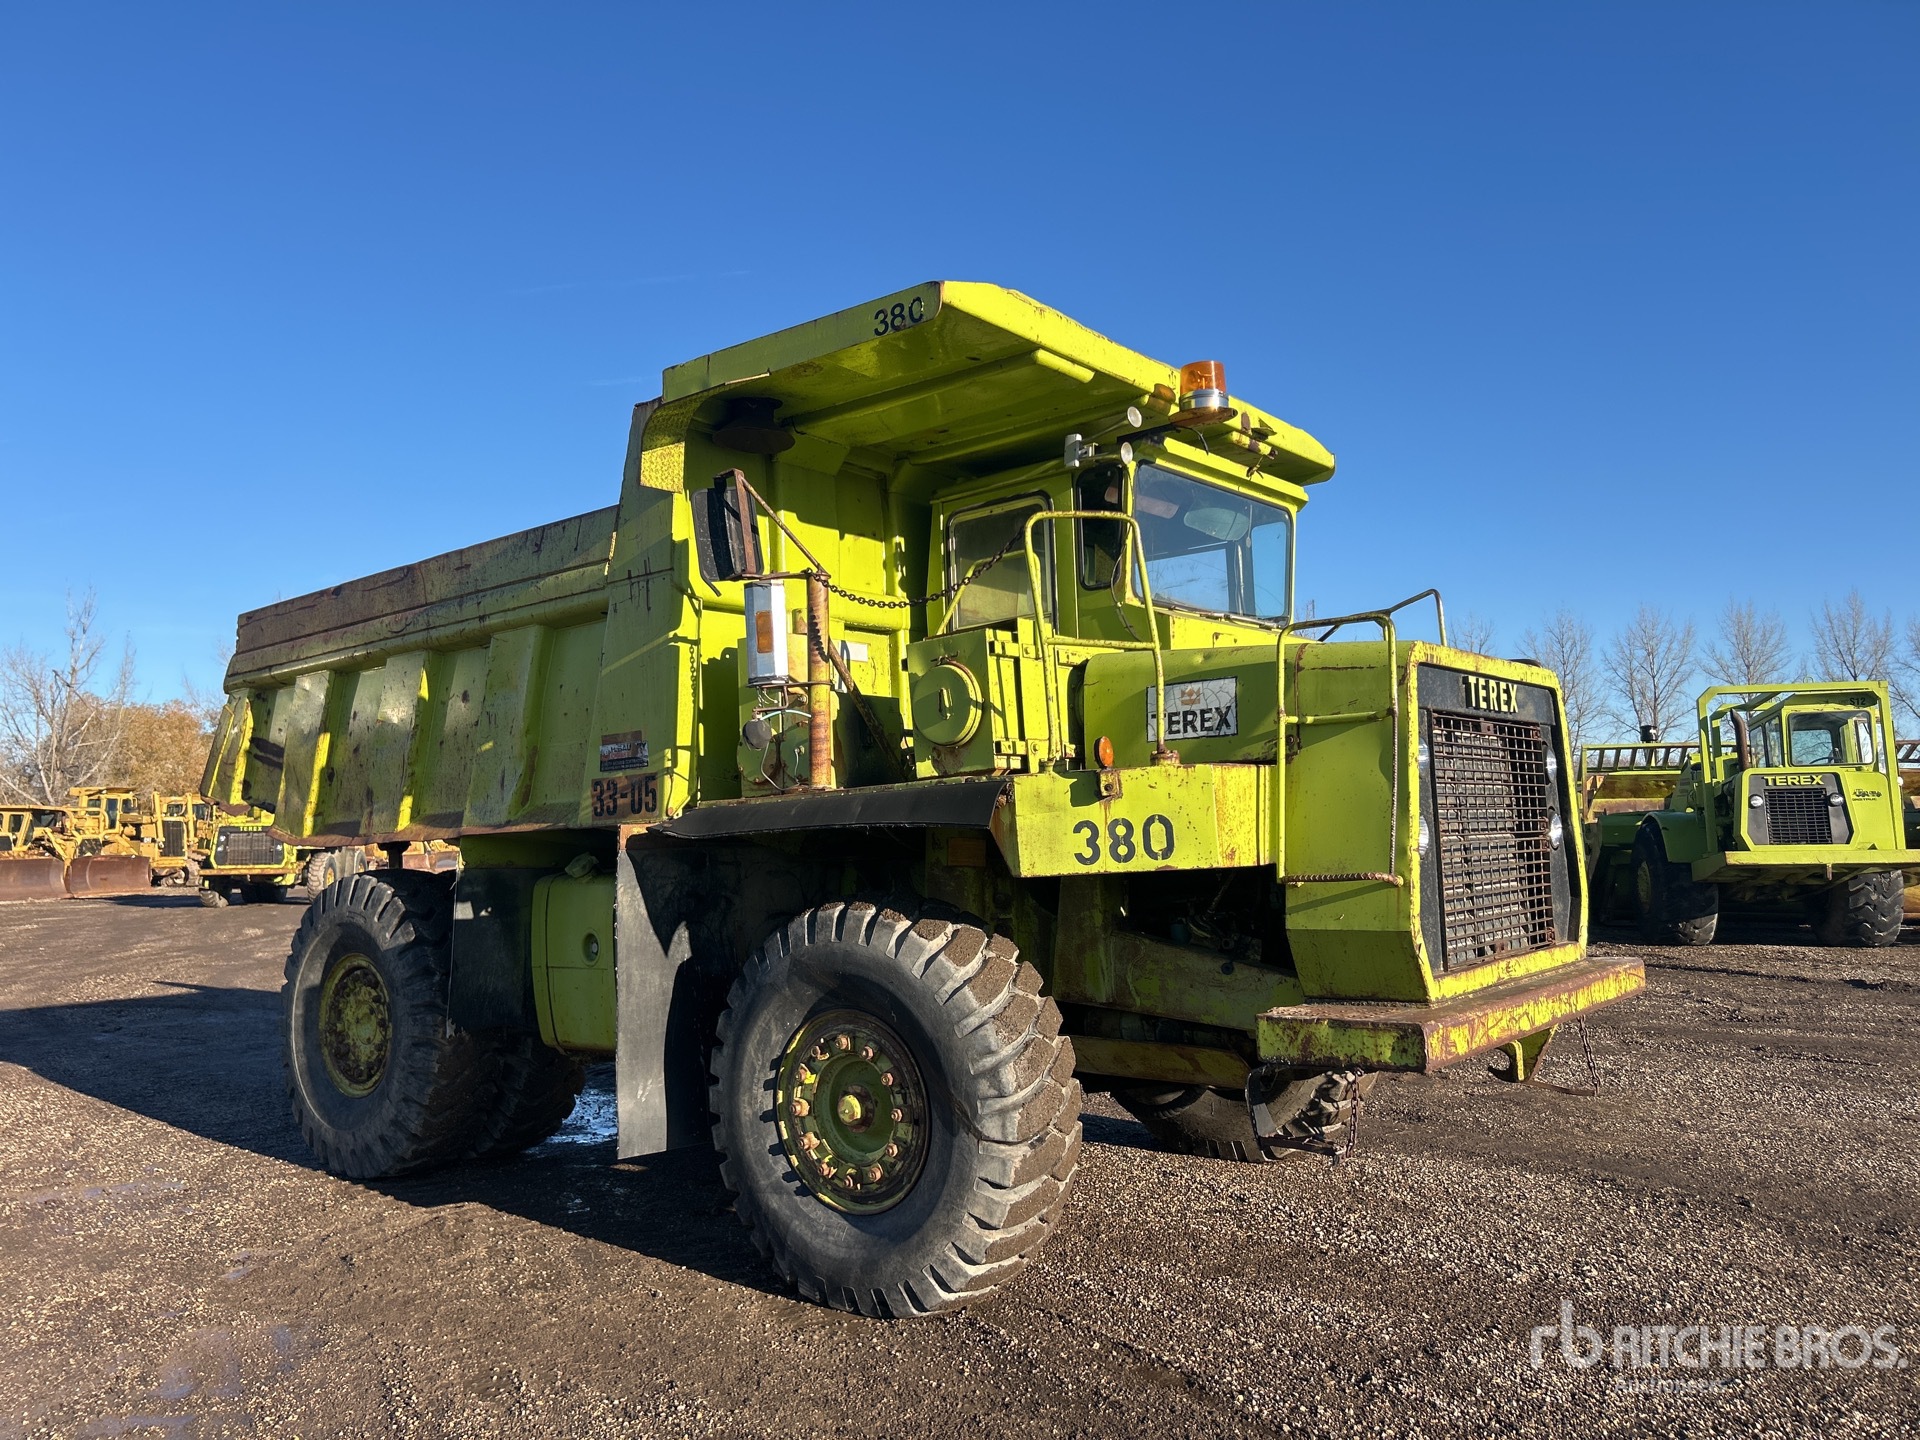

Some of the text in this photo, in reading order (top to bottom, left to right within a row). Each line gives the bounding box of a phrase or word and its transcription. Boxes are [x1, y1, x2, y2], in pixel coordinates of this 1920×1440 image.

[873, 296, 924, 336] 380
[1463, 675, 1519, 714] TEREX
[1849, 697, 1866, 706] S12
[593, 775, 657, 817] 33-05
[1762, 774, 1825, 787] TEREX
[1072, 813, 1175, 866] 380
